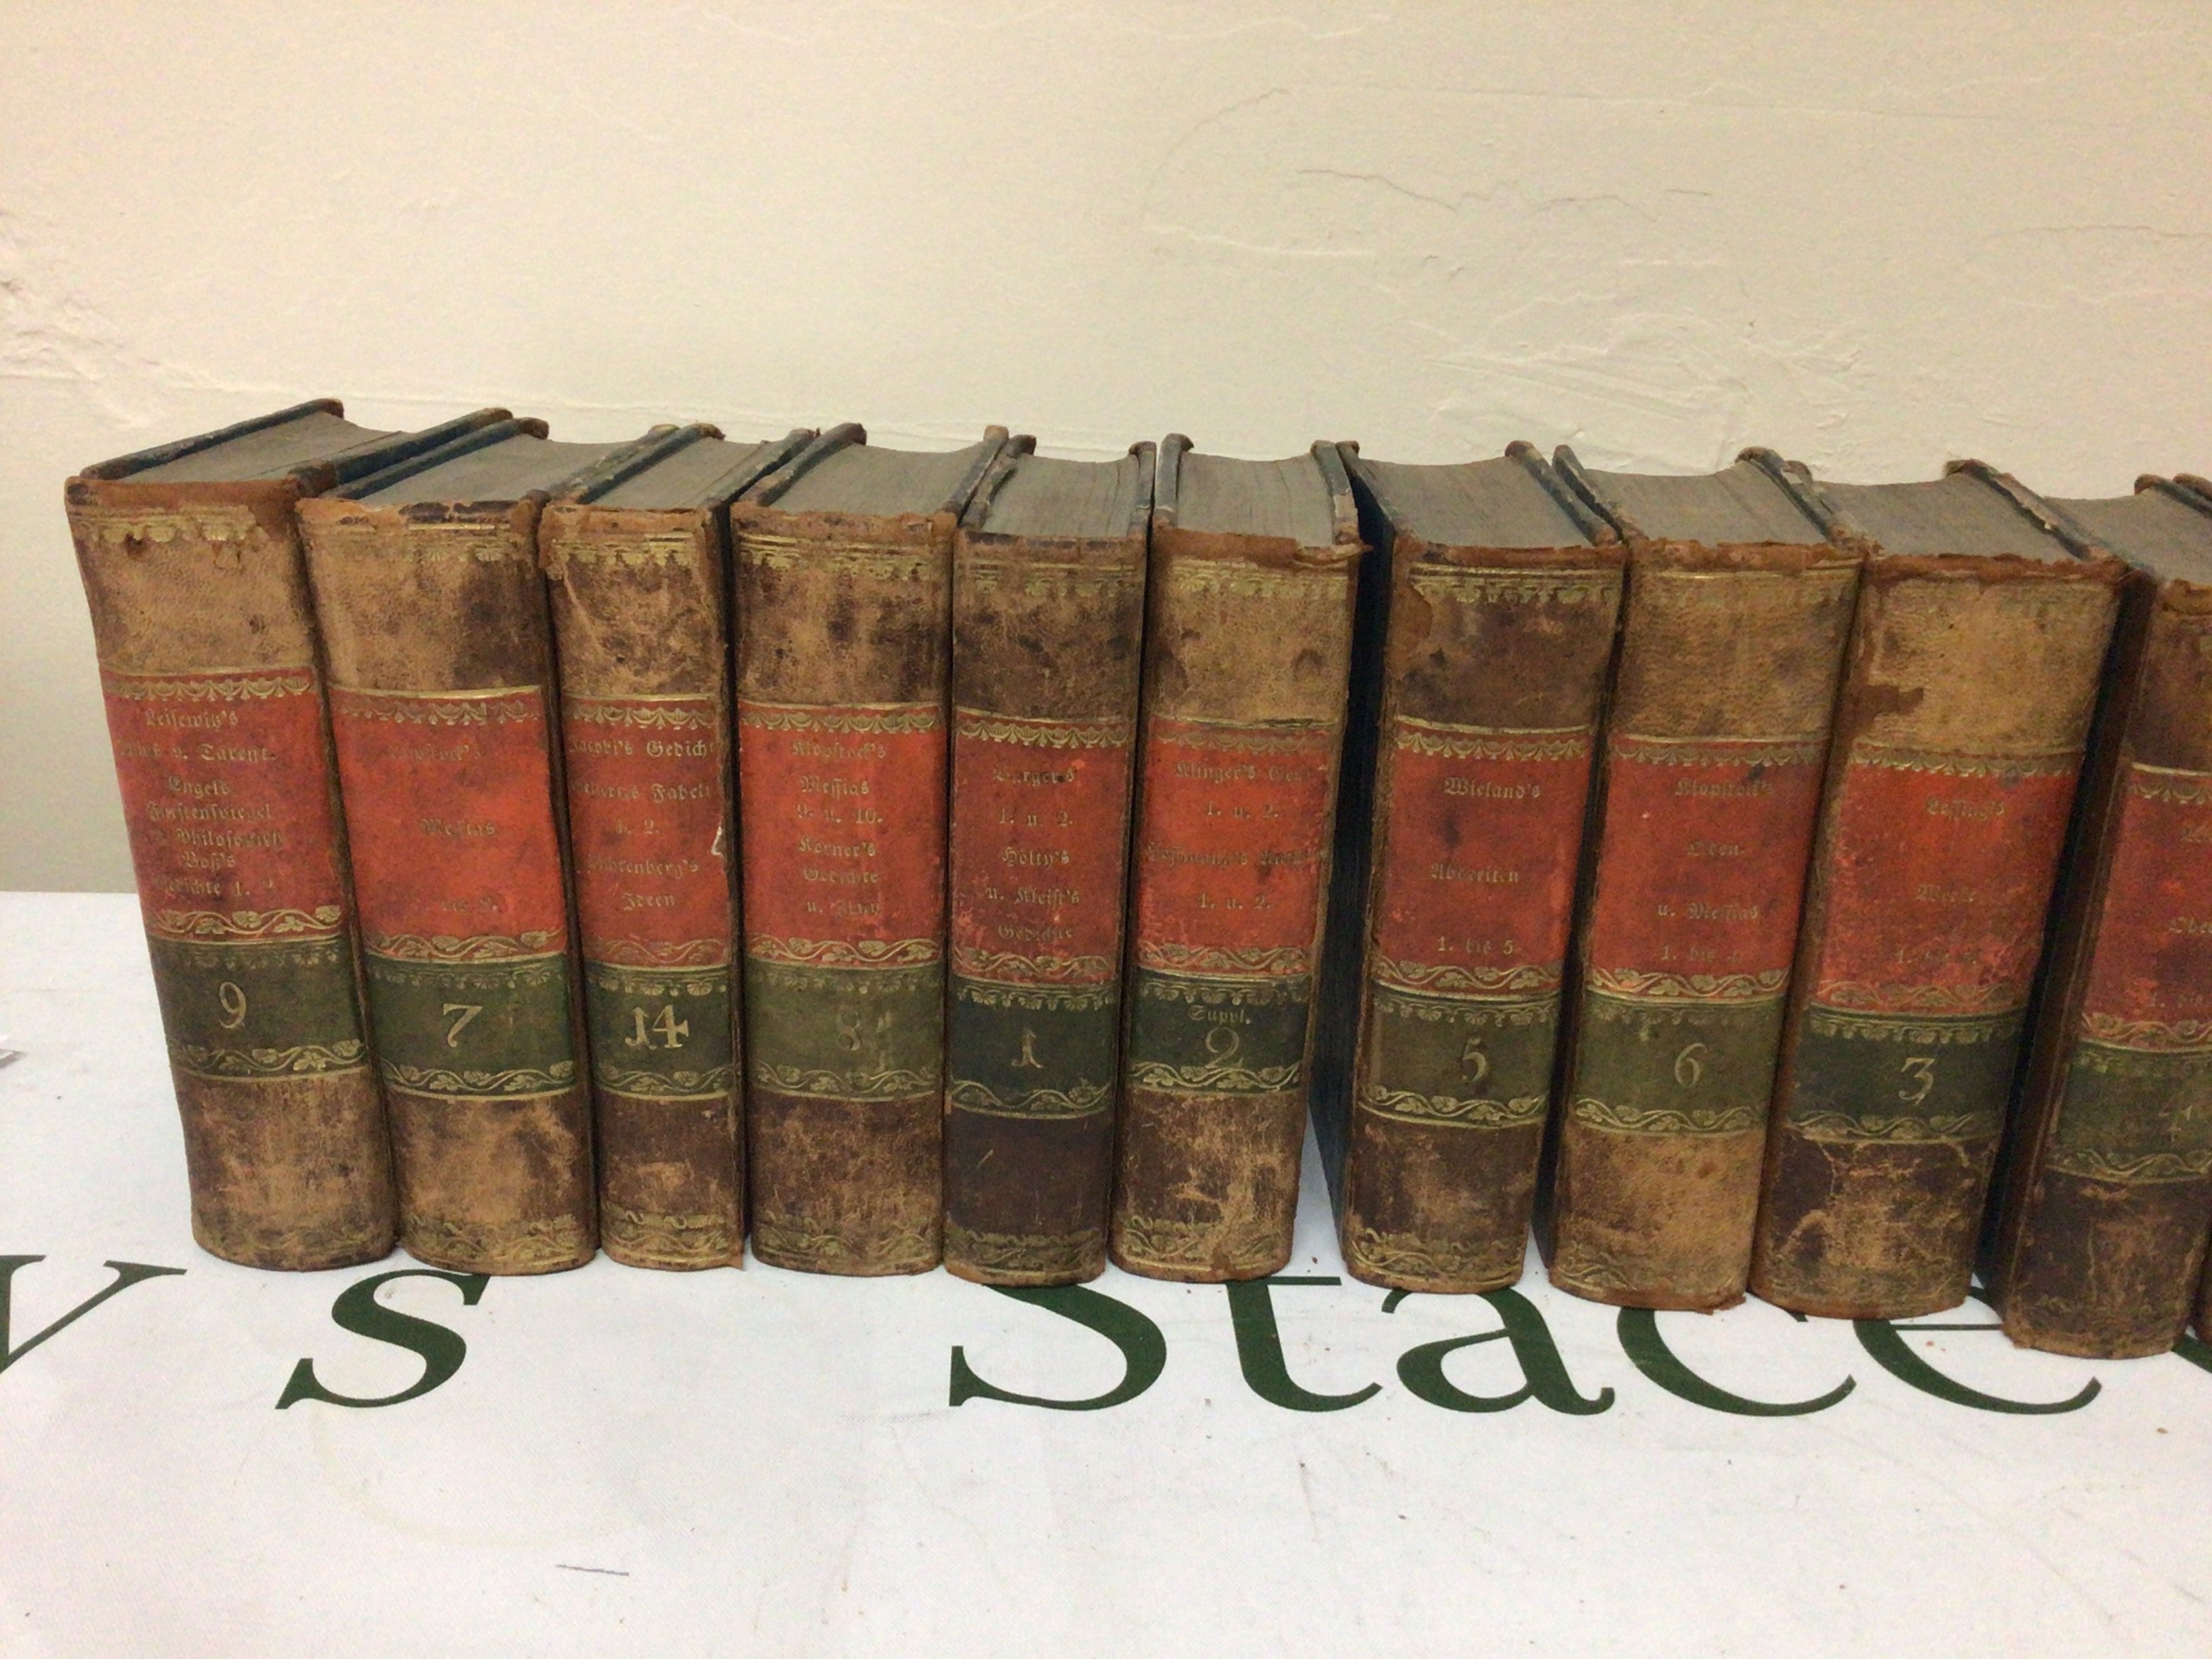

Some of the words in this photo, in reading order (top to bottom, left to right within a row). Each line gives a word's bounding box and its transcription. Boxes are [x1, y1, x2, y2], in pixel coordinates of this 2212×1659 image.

[218, 981, 247, 1029] 9
[441, 1003, 483, 1048] 7
[625, 1004, 690, 1050] 14
[1010, 1028, 1044, 1069] 1
[1205, 1026, 1244, 1069] 2
[1460, 1036, 1488, 1082] 5
[1674, 1042, 1708, 1086] 6
[1899, 1057, 1936, 1105] 3
